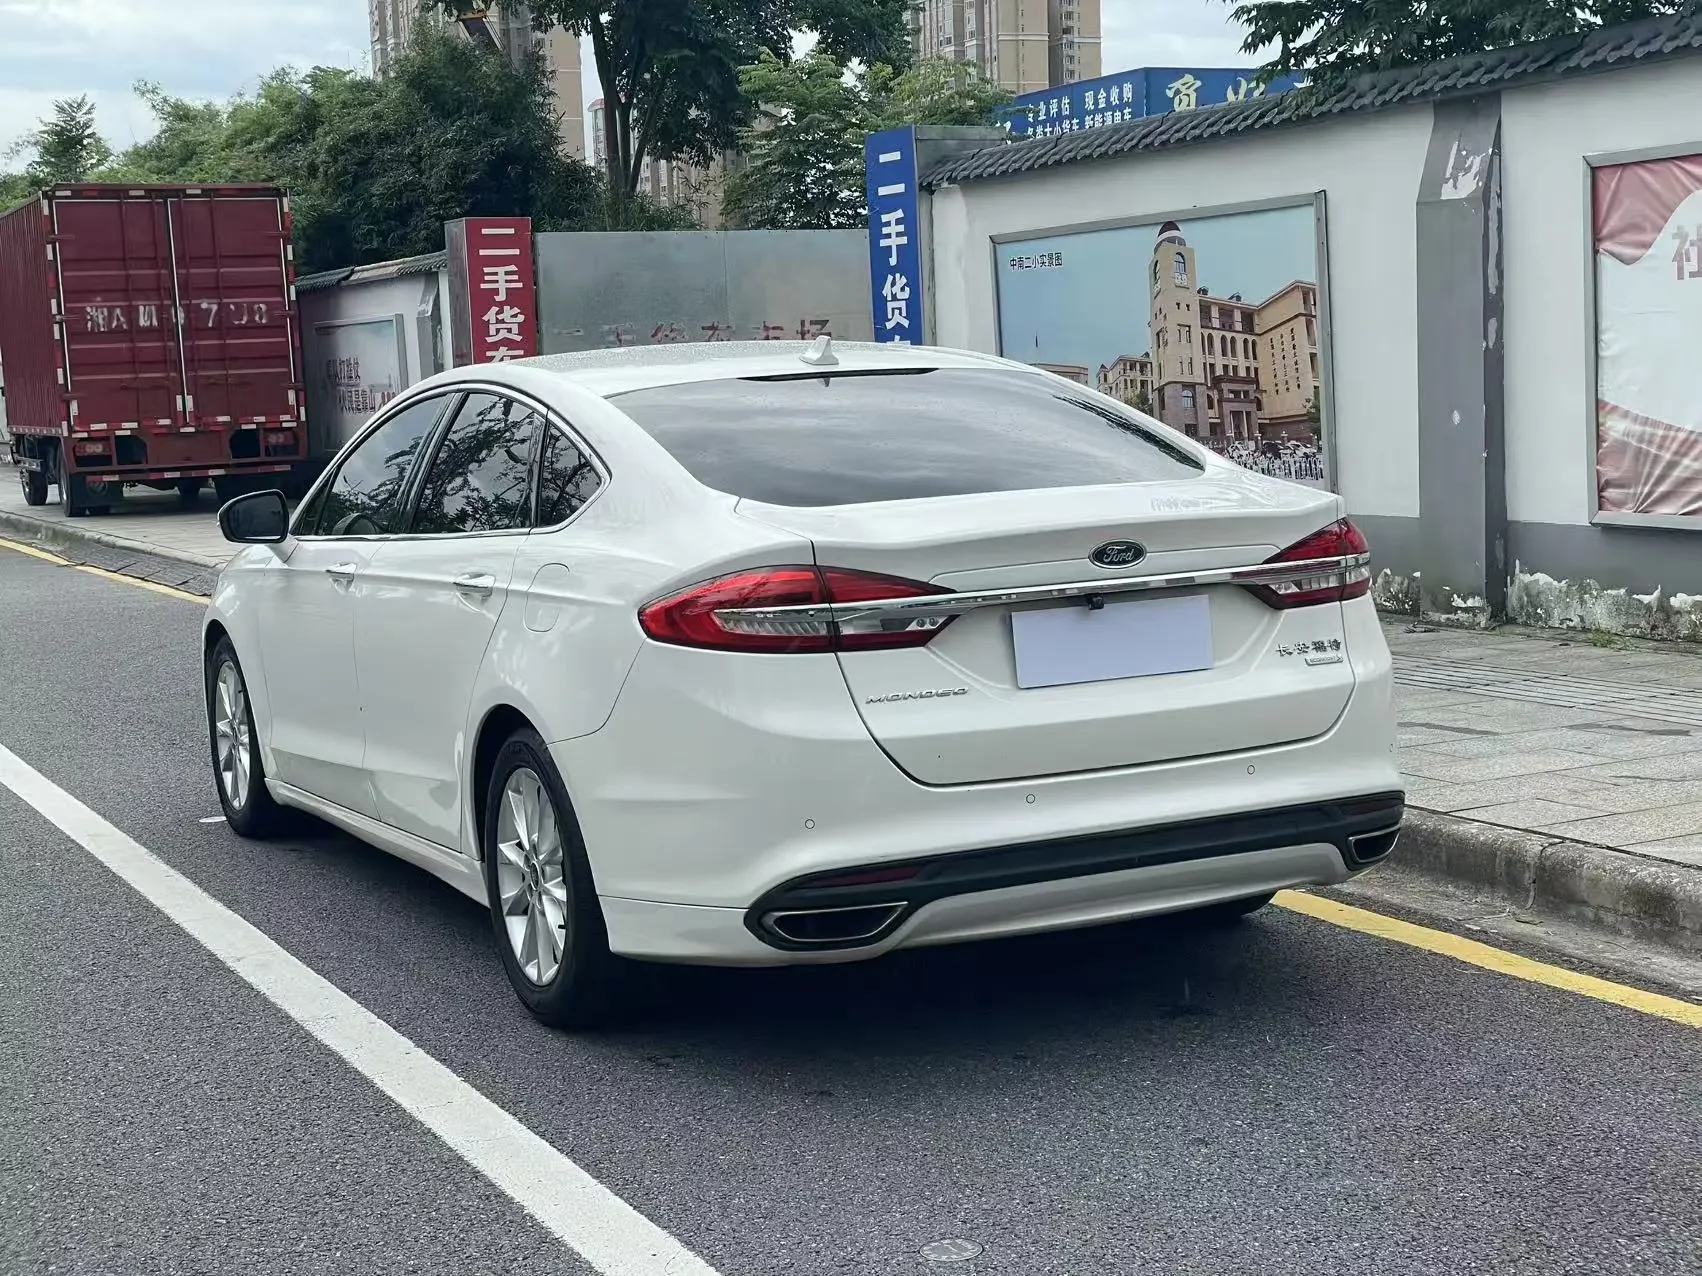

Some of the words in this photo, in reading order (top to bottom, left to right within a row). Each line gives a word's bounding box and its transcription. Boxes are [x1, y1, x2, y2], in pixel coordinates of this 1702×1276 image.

[1083, 81, 1133, 112] 现金收购
[877, 150, 912, 345] 二手货
[1009, 251, 1063, 271] 中南二小实景图
[1102, 545, 1135, 562] Ford
[865, 687, 969, 704] MONDEO
